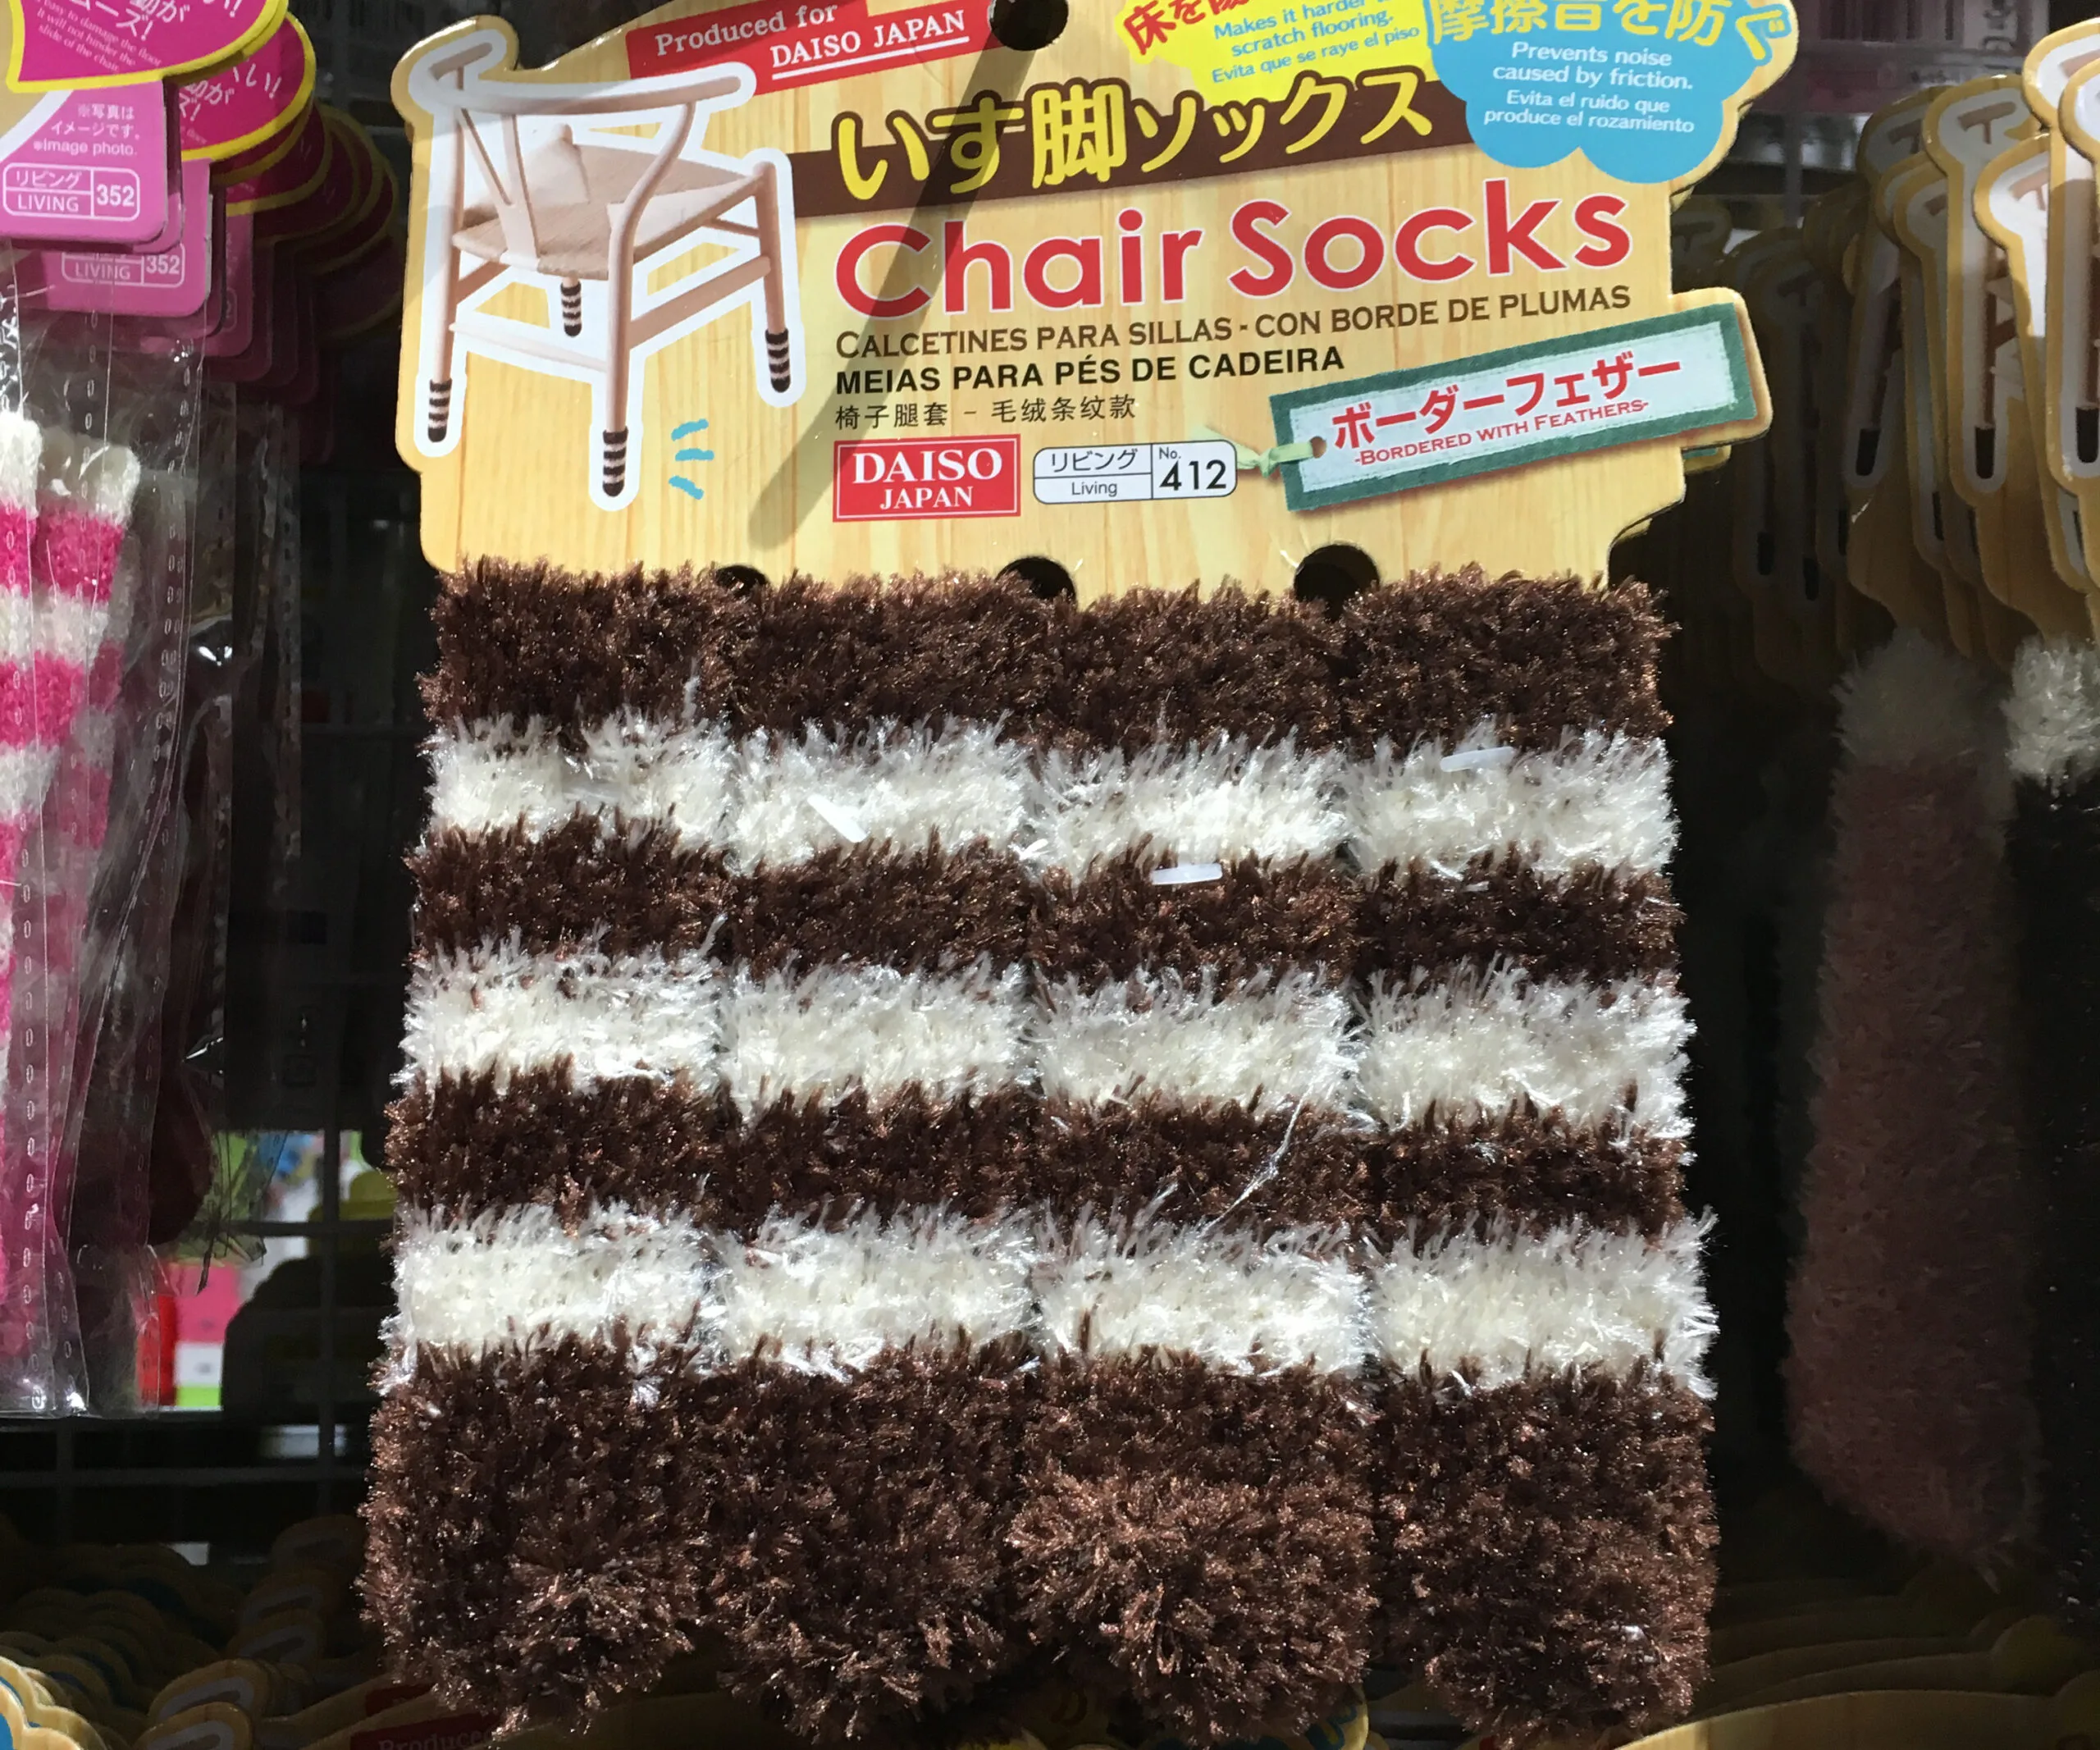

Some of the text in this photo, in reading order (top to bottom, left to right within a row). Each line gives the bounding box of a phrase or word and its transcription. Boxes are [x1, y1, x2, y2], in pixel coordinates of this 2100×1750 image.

[655, 5, 838, 56] Produced for
[1214, 16, 1277, 39] Makes
[1283, 8, 1297, 24] it
[1231, 10, 1394, 57] scratch flooring.
[770, 10, 966, 67] DAISO JAPAN
[1212, 25, 1421, 84] Evita que se raye el piso
[1512, 41, 1673, 66] Prevents noise
[1492, 63, 1694, 90] caused by friction.
[1506, 89, 1670, 117] Evita el ruido que
[1483, 108, 1695, 134] produce el rozamiento
[93, 141, 138, 157] photo.
[837, 73, 1434, 200] いす脚ソックス
[16, 169, 82, 189] リビング
[18, 194, 80, 212] LIVING
[96, 185, 135, 207] 352
[836, 178, 1632, 318] Chair Socks
[75, 262, 130, 281] LIVING
[146, 255, 180, 275] 352
[836, 327, 1028, 359] CALCETINES
[1037, 323, 1121, 350] PARA
[1128, 317, 1232, 345] SILLAS
[1254, 311, 1322, 338] CON
[1331, 300, 1439, 334] BORDE
[1448, 296, 1491, 322] DE
[1499, 285, 1632, 319] PLUMAS
[836, 346, 1344, 395] MEIAS PARA PÉS DE CADEIRA
[835, 401, 949, 430] 椅子腿套
[991, 393, 1136, 423] 毛绒条纹款
[1332, 351, 1682, 451] ボーダーフェザー
[1476, 420, 1529, 442] WITH
[853, 447, 1003, 486] DAISO
[1051, 447, 1139, 473] リビング
[1158, 446, 1182, 460] No.
[1071, 480, 1119, 498] Living
[1158, 460, 1227, 491] 412
[879, 486, 975, 510] JAPAN
